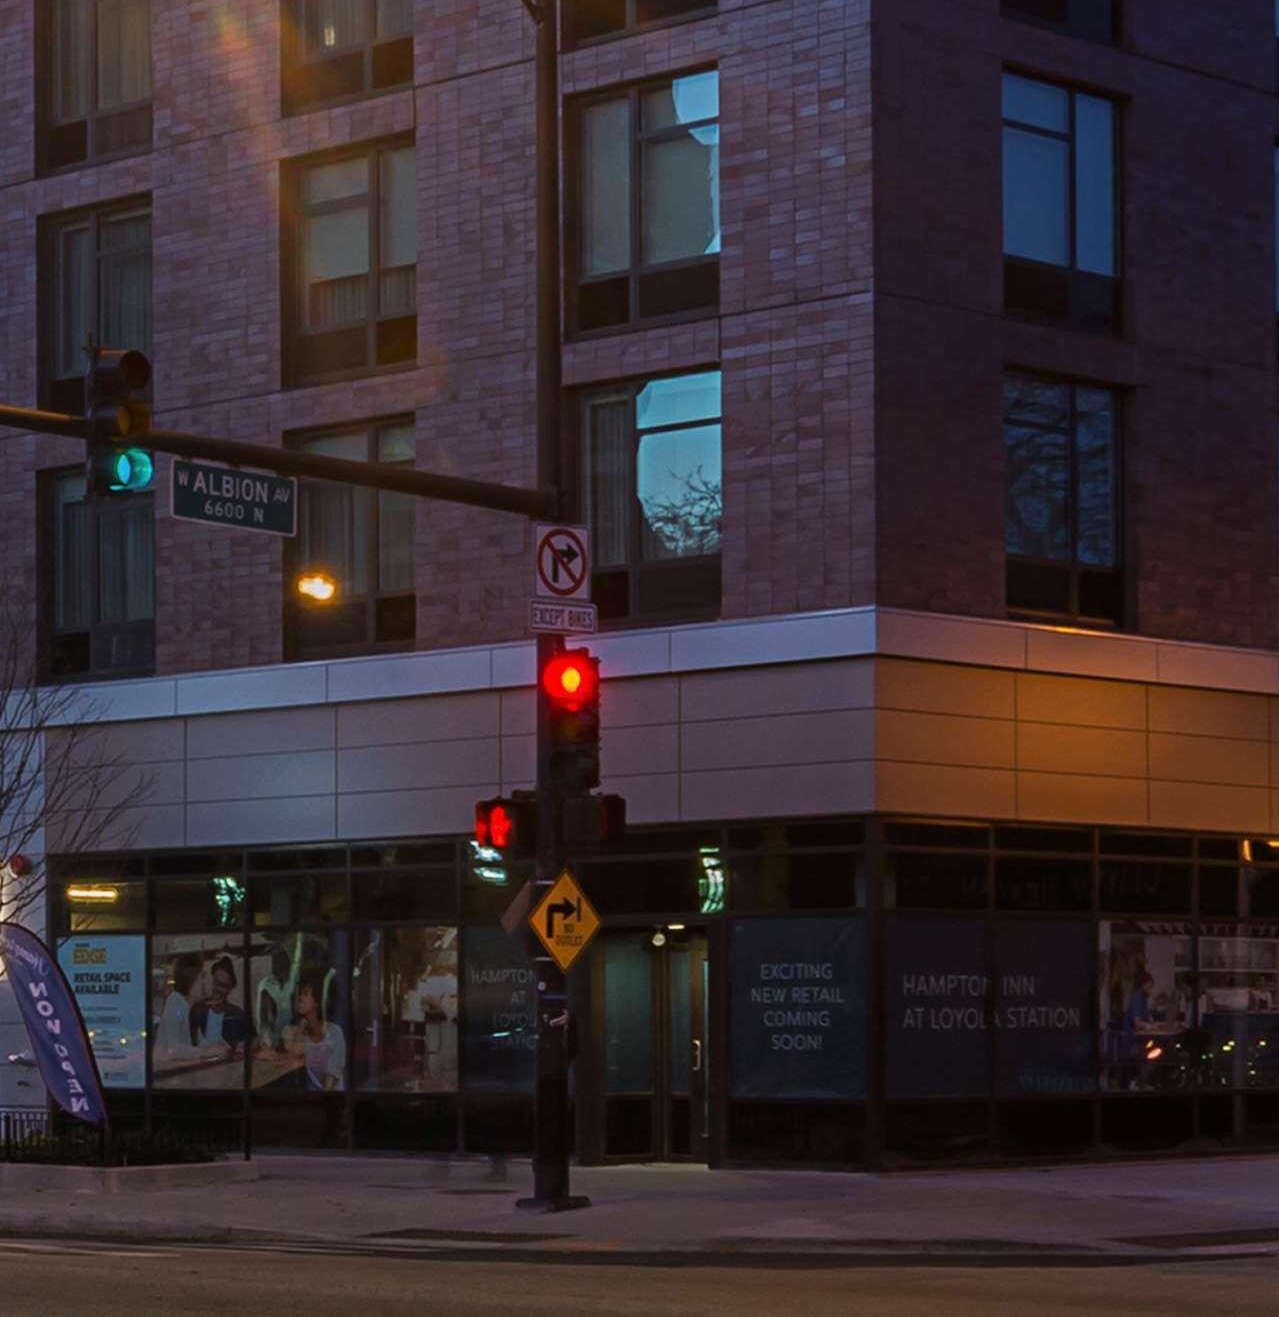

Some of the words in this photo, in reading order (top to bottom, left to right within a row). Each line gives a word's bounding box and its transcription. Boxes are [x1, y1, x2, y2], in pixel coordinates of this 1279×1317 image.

[177, 471, 189, 486] W
[192, 471, 268, 503] ALBION
[273, 487, 291, 502] AV
[204, 500, 245, 520] 6600
[253, 507, 264, 523] N
[563, 922, 575, 933] NO
[74, 973, 102, 983] RETAIL
[103, 971, 131, 983] SPACE
[760, 963, 833, 980] EXCITING
[74, 984, 120, 995] AVAILABLE
[1002, 975, 1036, 996] INN
[510, 989, 527, 1004] AT
[751, 987, 787, 1002] NEW
[791, 986, 846, 1003] RETAIL
[493, 1012, 538, 1028] LOYOL
[763, 1010, 831, 1027] COMING
[902, 1007, 925, 1029] AT
[1006, 1006, 1081, 1029] STATION
[771, 1034, 823, 1050] SOON!
